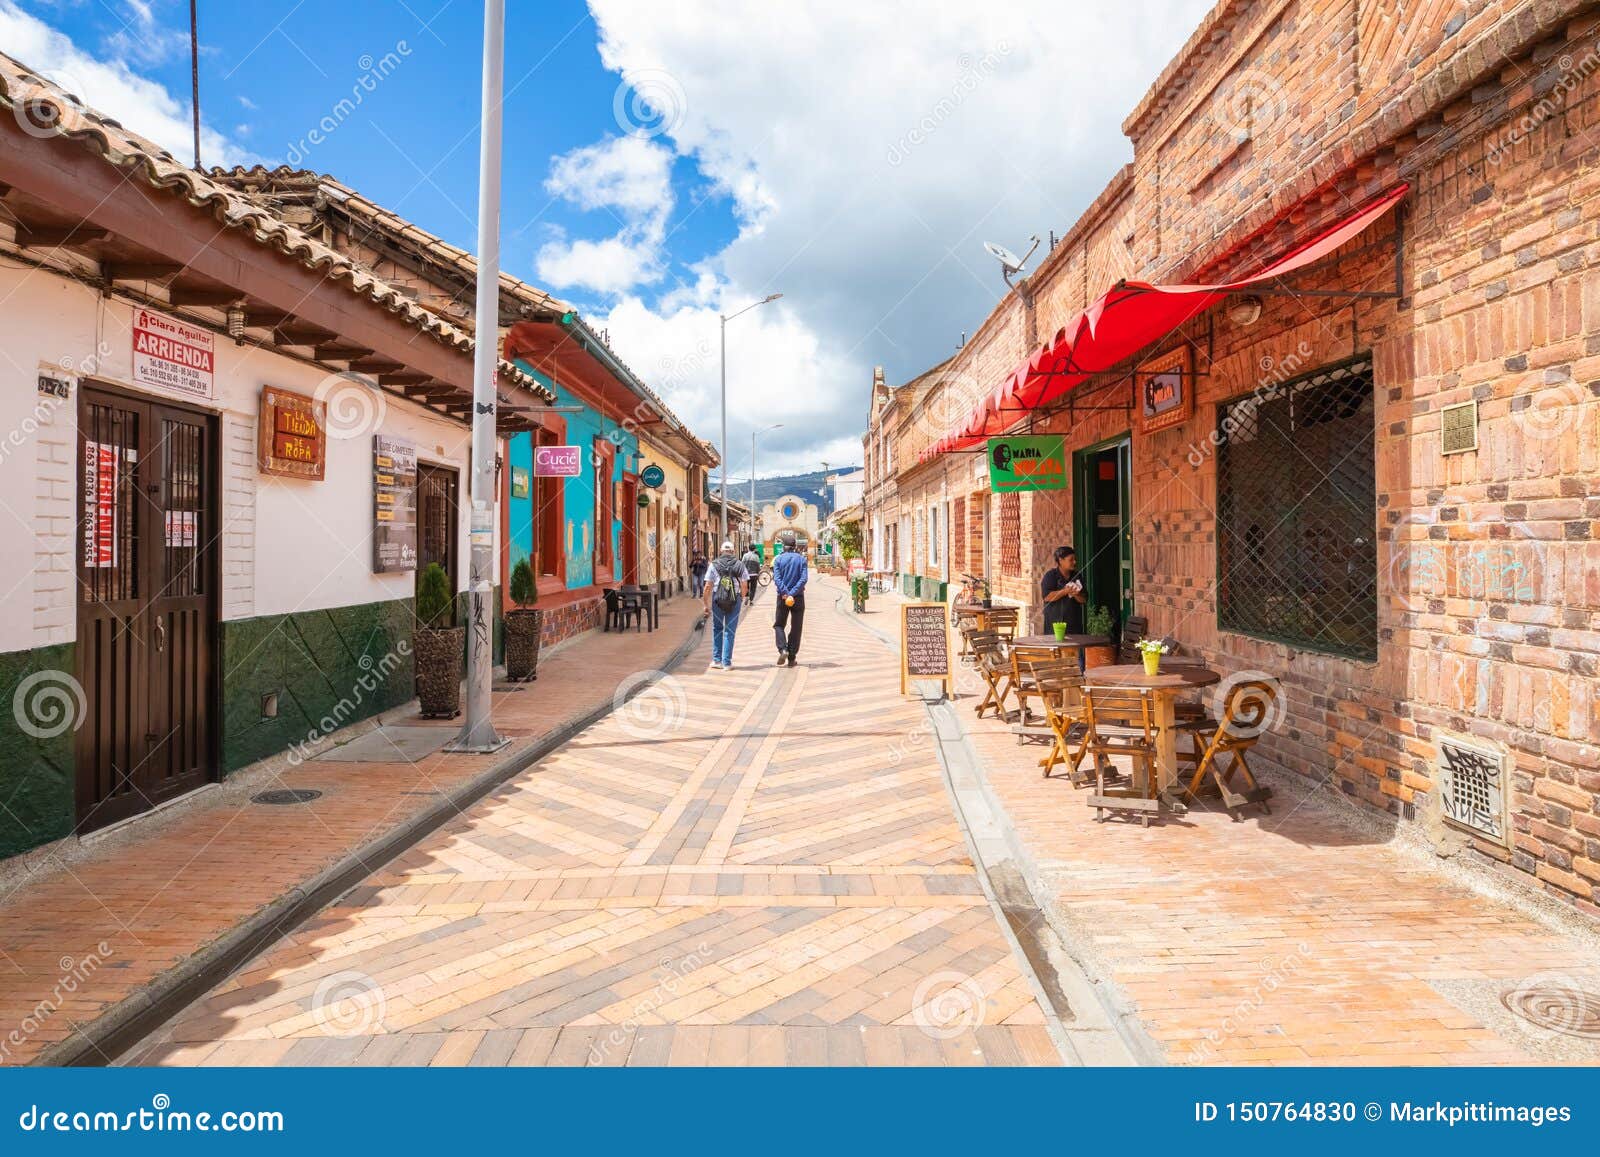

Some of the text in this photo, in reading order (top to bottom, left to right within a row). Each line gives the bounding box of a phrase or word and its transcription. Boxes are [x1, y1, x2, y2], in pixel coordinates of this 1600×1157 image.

[150, 317, 210, 344] Clara Aguilar
[137, 333, 210, 370] ARRIENDA
[284, 413, 316, 435] TIENDA
[296, 411, 304, 421] LA
[87, 446, 95, 467] 863
[285, 442, 311, 460] ROPA
[1013, 448, 1041, 458] MARIA
